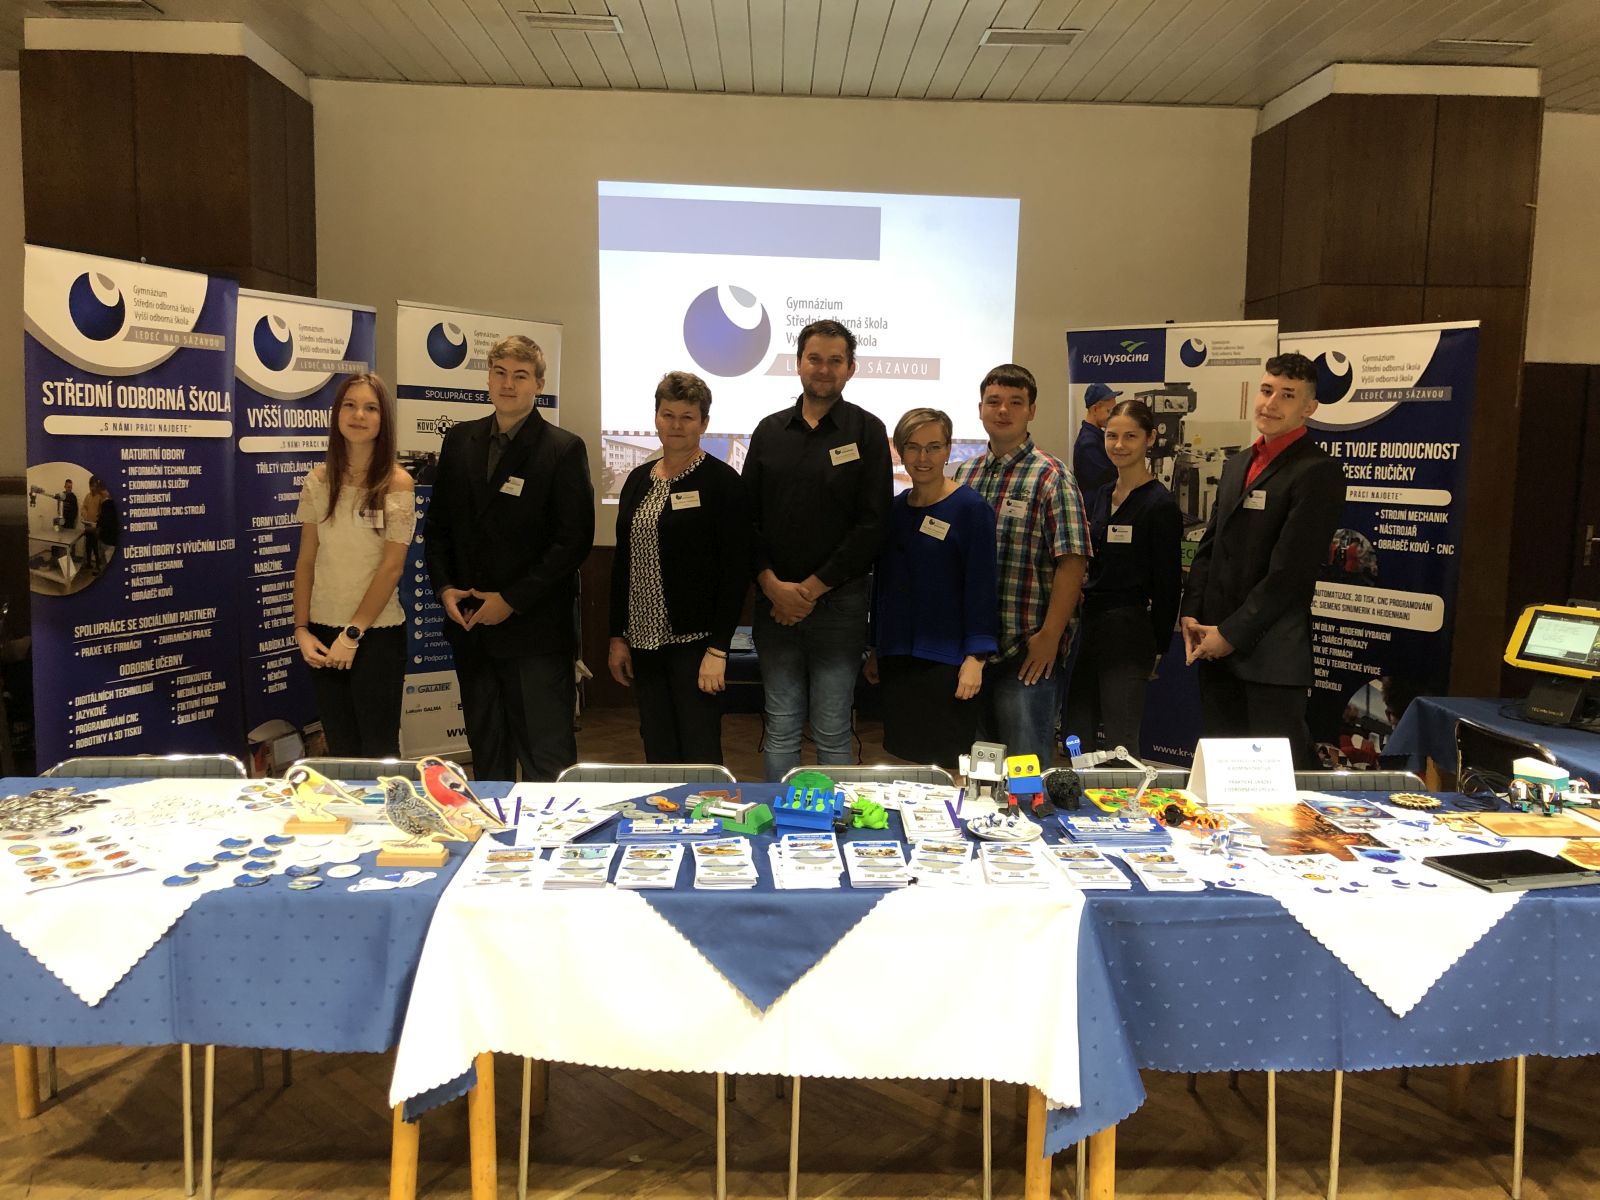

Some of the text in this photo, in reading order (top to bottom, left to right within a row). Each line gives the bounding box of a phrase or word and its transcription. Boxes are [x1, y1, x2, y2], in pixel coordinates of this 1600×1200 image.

[133, 284, 168, 298] Gymnázium
[156, 300, 178, 312] odborná
[180, 302, 195, 314] škola
[786, 297, 843, 311] Gymnázium
[150, 313, 173, 324] odborná
[173, 314, 189, 325] škola
[864, 317, 888, 329] škola
[164, 334, 180, 344] NAD
[1083, 354, 1101, 366] Kraj
[868, 360, 928, 376] SÁZAVOU
[42, 378, 231, 413] STŘEDNÍ ODBORNÁ ŠKOLA
[425, 389, 473, 401] SPOLUPRÁCE
[475, 393, 485, 401] SE
[1360, 390, 1384, 400] LEDEČ
[1406, 389, 1444, 399] SÁZAVOU
[247, 404, 281, 428] VYŠŠÍ
[113, 422, 133, 431] NÁMI
[417, 419, 433, 431] KOVO
[121, 447, 185, 460] MATURITNÍ OBORY
[1330, 442, 1342, 457] JE
[1345, 442, 1377, 458] TVOJE
[1380, 442, 1460, 460] BUDOUCNOST
[164, 466, 202, 475] TECHNOLOGIE
[1374, 463, 1416, 481] RUČIČKY
[129, 478, 189, 489] EKONOMIKA A SLUŽBY
[129, 492, 171, 504] STROJÍRENSTVÍ
[130, 506, 171, 518] PROGRAMÁTOR
[172, 507, 183, 515] CNC
[1380, 509, 1449, 523] STROJNÍ MECHANIK
[252, 516, 273, 527] FORMY
[1379, 524, 1417, 537] NÁSTROJAŘ
[124, 544, 151, 559] UČEBNÍ
[152, 543, 175, 556] OBORY
[176, 543, 181, 554] S
[183, 539, 216, 553] VÝUČNÍM
[1378, 539, 1455, 555] OBRÁBĚČ KOVŮ CNC
[254, 560, 283, 573] NABÍZÍME
[1377, 597, 1388, 605] CNC
[1389, 598, 1433, 611] PROGRAMOVÁNÍ
[74, 608, 217, 638] SPOLUPRÁCE SE SOCIÁLNÍMI PARTNERY
[193, 629, 212, 640] PRAXE
[81, 640, 142, 658] PRAXE VE FIRMÁCH
[259, 637, 285, 652] NABÍDKA
[119, 654, 184, 676] ODBORNÉ UČEBNY
[75, 689, 114, 707] DIGITÁLNÍCH
[75, 704, 107, 721] JAZYKOVÉ
[75, 713, 139, 735] PROGRAMOVÁNÍ CNC
[76, 726, 142, 749] ROBOTIKY A 3D TISKU
